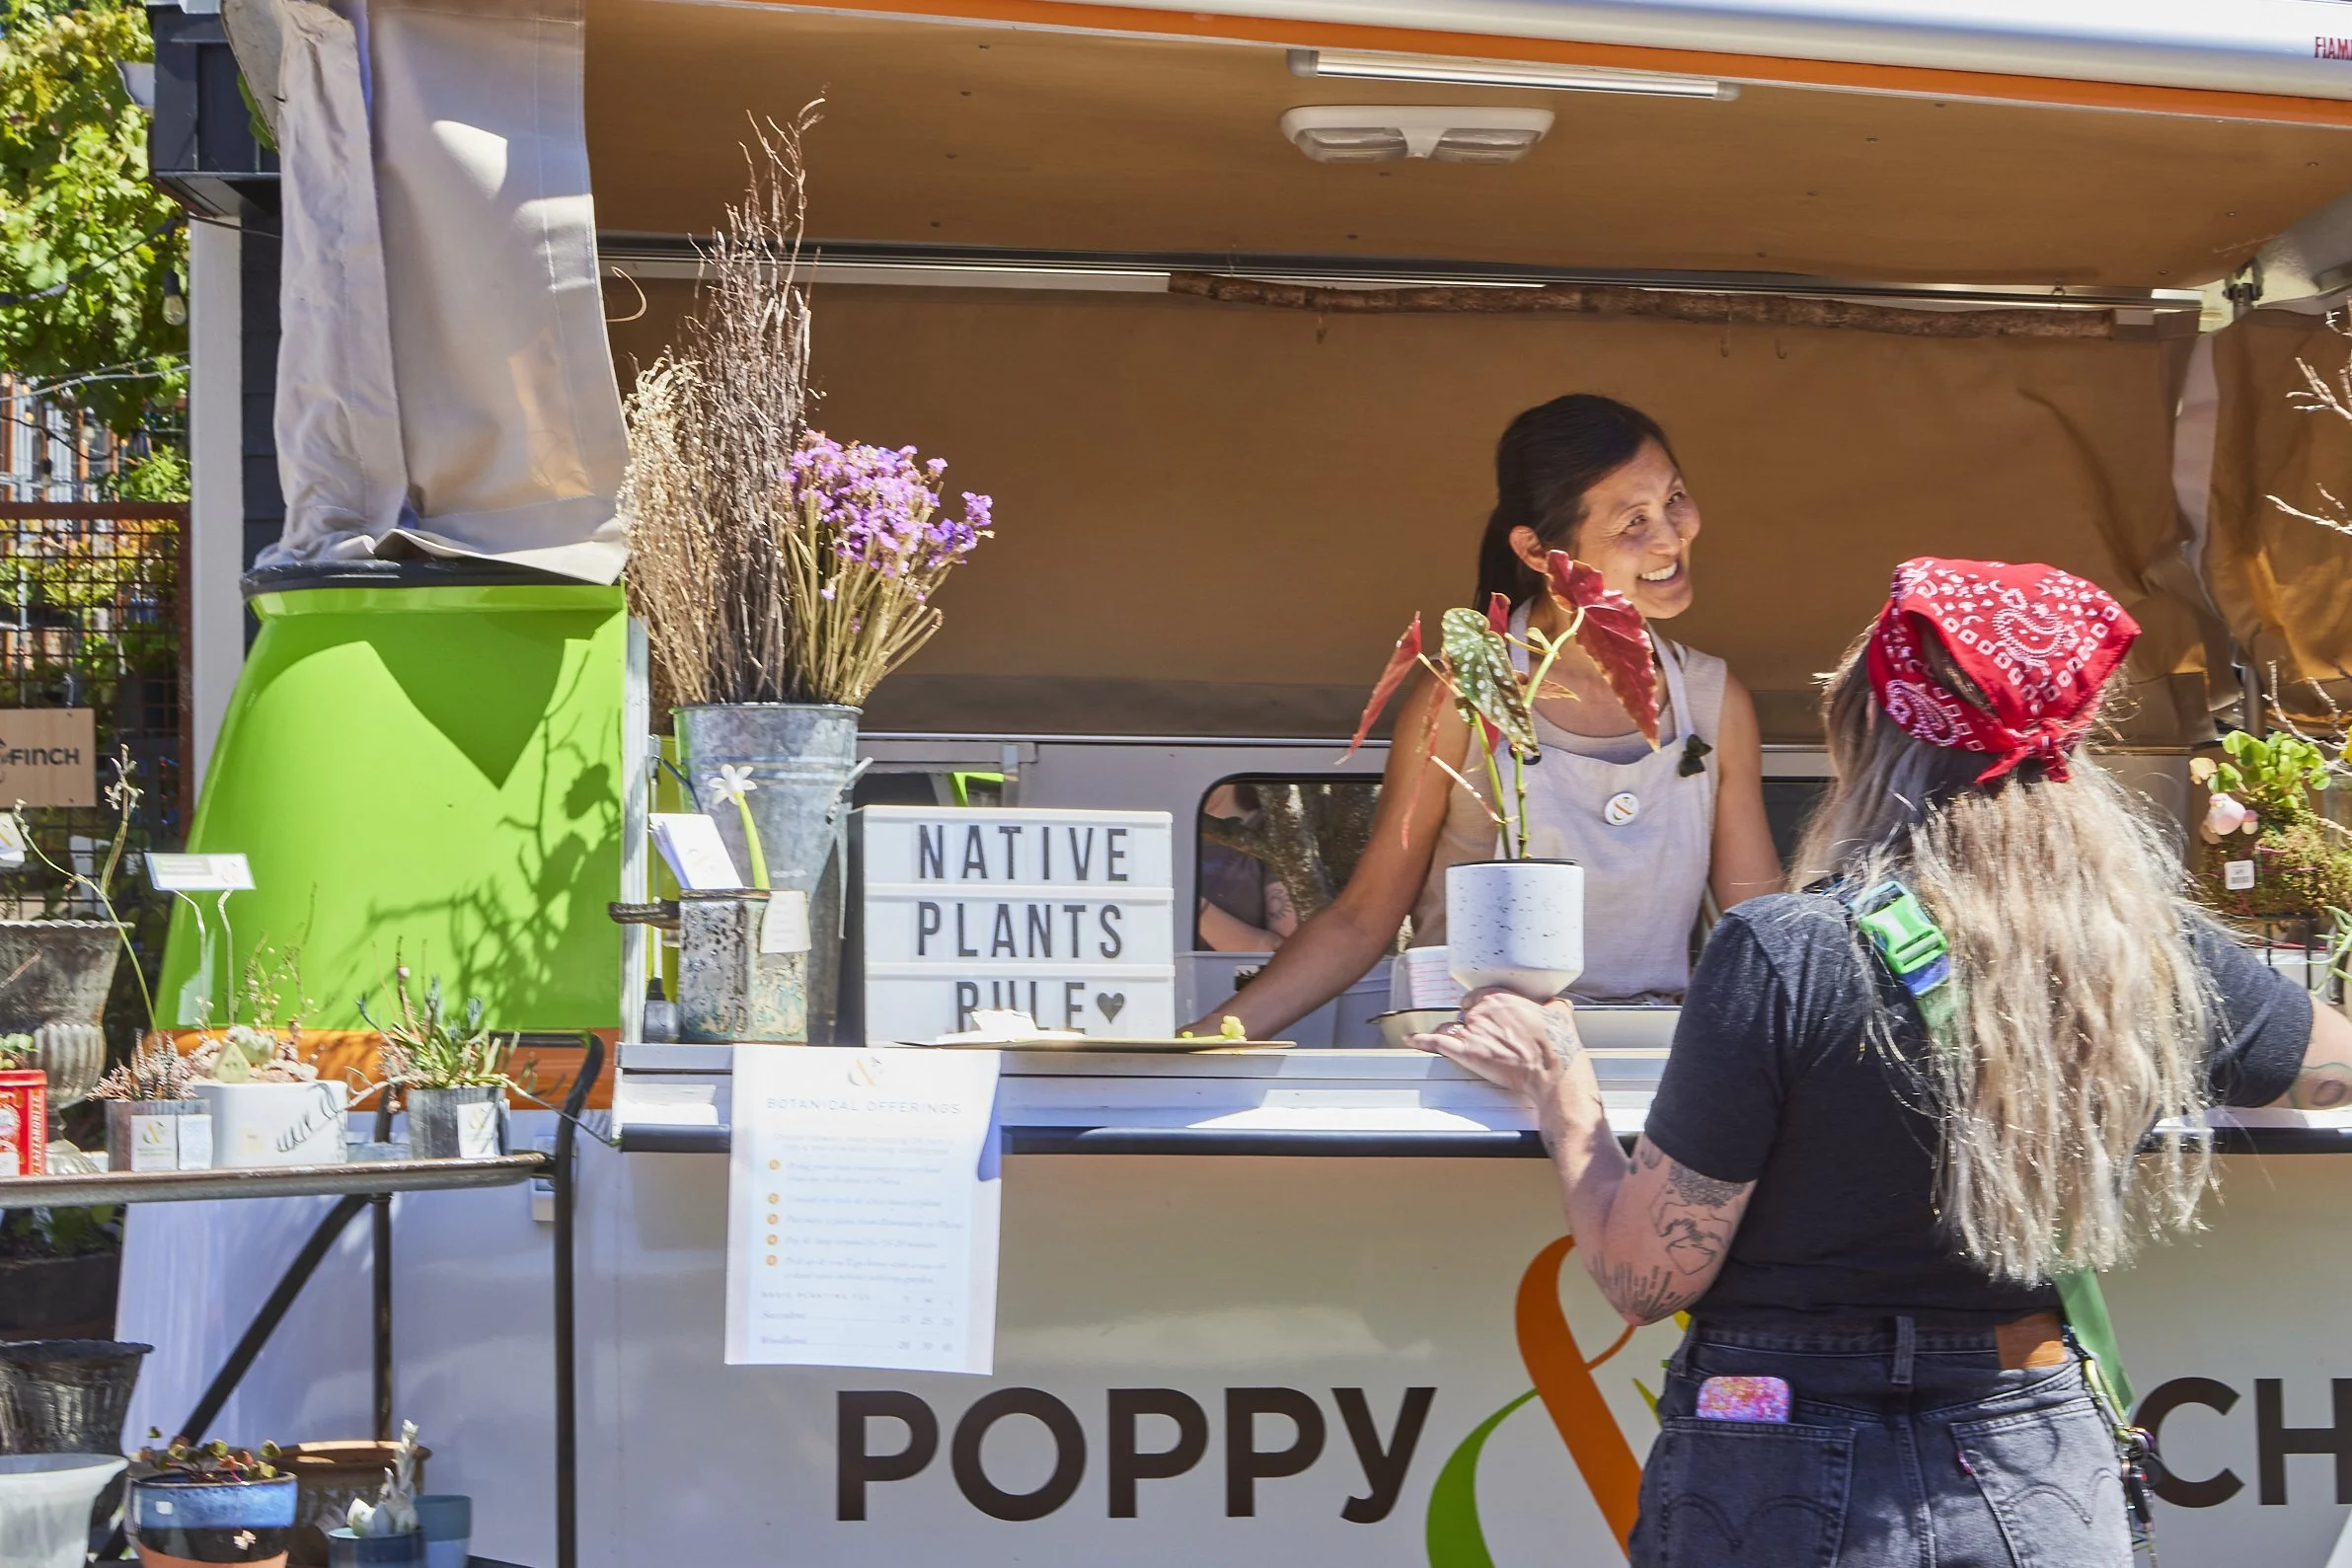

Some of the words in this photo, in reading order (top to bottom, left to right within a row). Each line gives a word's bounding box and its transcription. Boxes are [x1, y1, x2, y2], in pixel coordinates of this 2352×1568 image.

[2314, 37, 2352, 61] FIAM
[9, 747, 80, 766] FINCH
[919, 825, 1128, 881] NATIVE
[918, 901, 1122, 958] PLANTS
[766, 1097, 859, 1112] BOTANICAL
[868, 1100, 961, 1114] OFFERINGS
[836, 1386, 1438, 1524] POPPY
